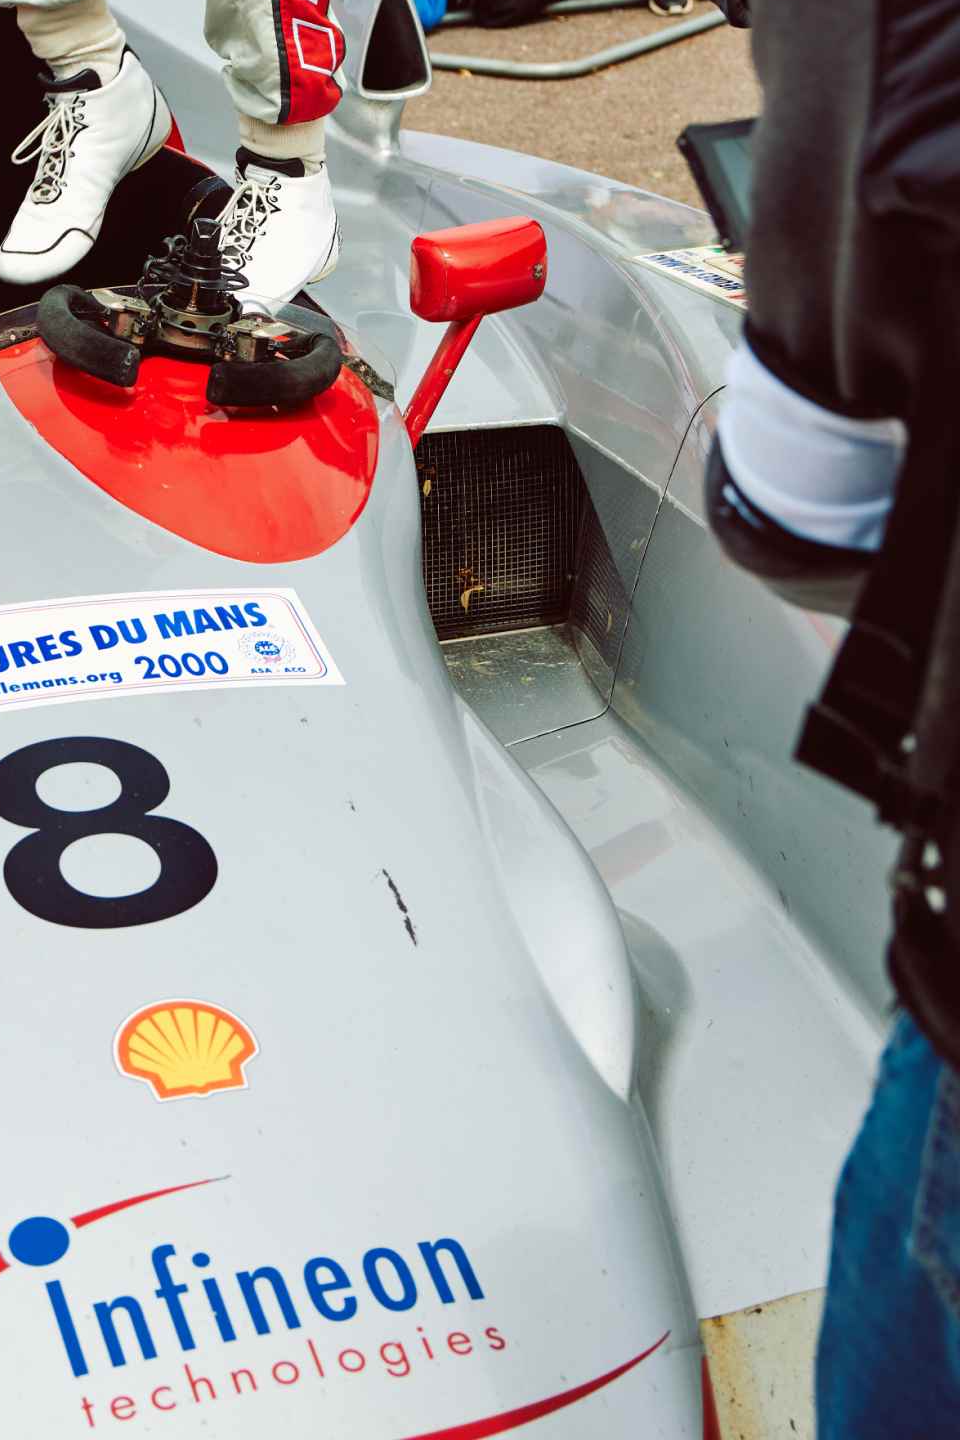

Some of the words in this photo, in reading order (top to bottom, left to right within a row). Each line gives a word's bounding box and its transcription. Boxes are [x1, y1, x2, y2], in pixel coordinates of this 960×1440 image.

[88, 618, 148, 651] DU
[153, 602, 268, 640] MANS
[133, 651, 229, 680] 2000
[44, 1236, 486, 1379] Infineon
[81, 1326, 507, 1428] technologies
